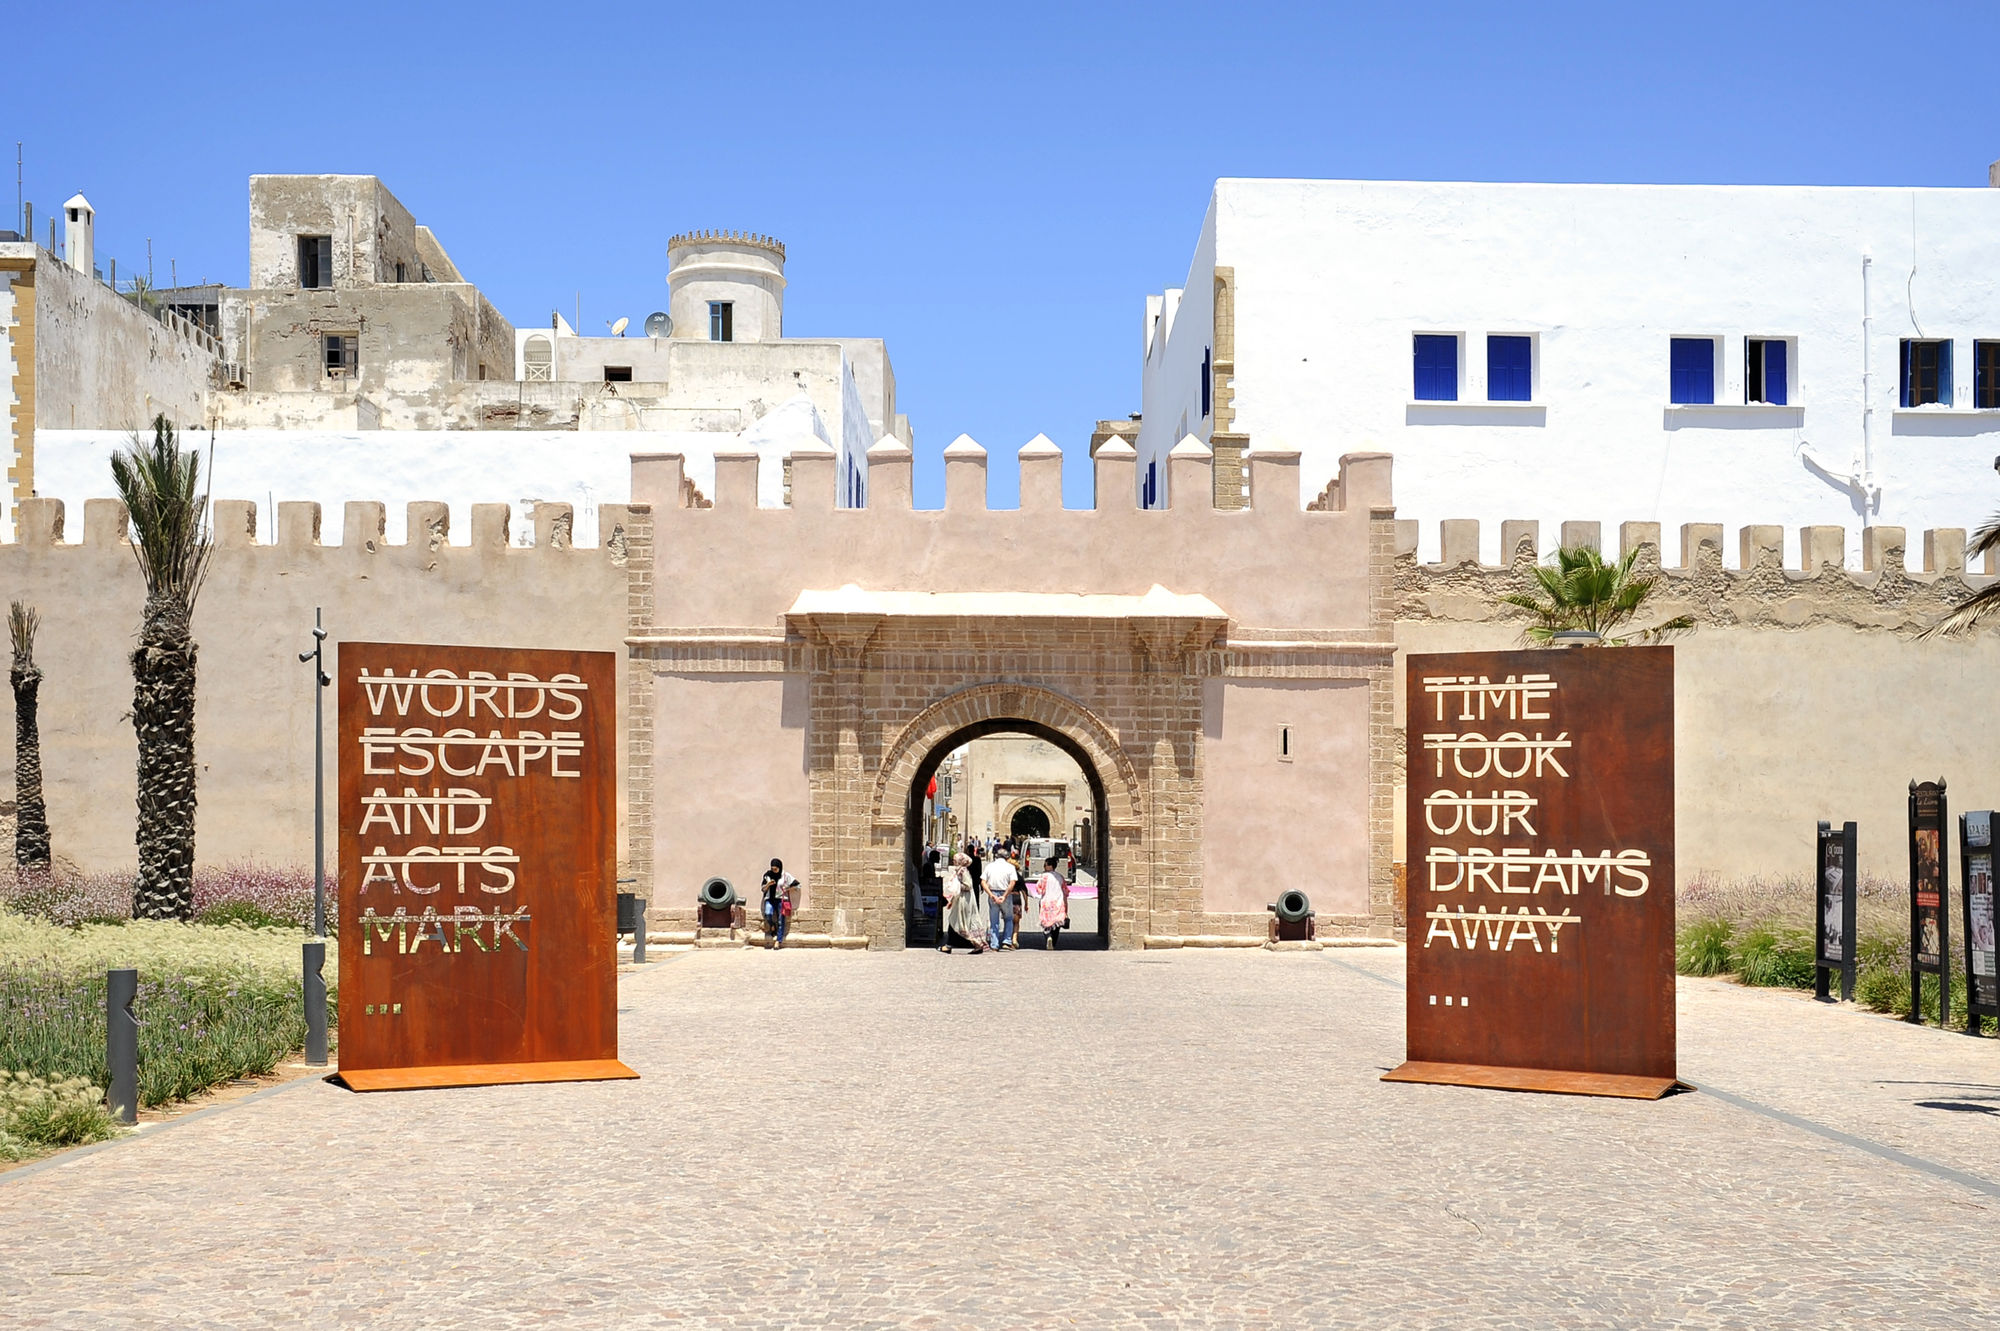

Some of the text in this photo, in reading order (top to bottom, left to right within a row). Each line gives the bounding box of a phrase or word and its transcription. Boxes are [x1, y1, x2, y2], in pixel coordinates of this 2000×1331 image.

[360, 667, 583, 721] WORDS
[1423, 674, 1555, 721] TIME
[361, 727, 582, 778] ESCAPE
[1423, 731, 1570, 778] TOOK
[359, 787, 488, 836] AND
[1424, 789, 1537, 836] OUR
[359, 845, 517, 895] ACTS
[1428, 847, 1650, 897] DREAMS
[361, 904, 530, 955] MARK
[1424, 904, 1571, 953] AWAY
